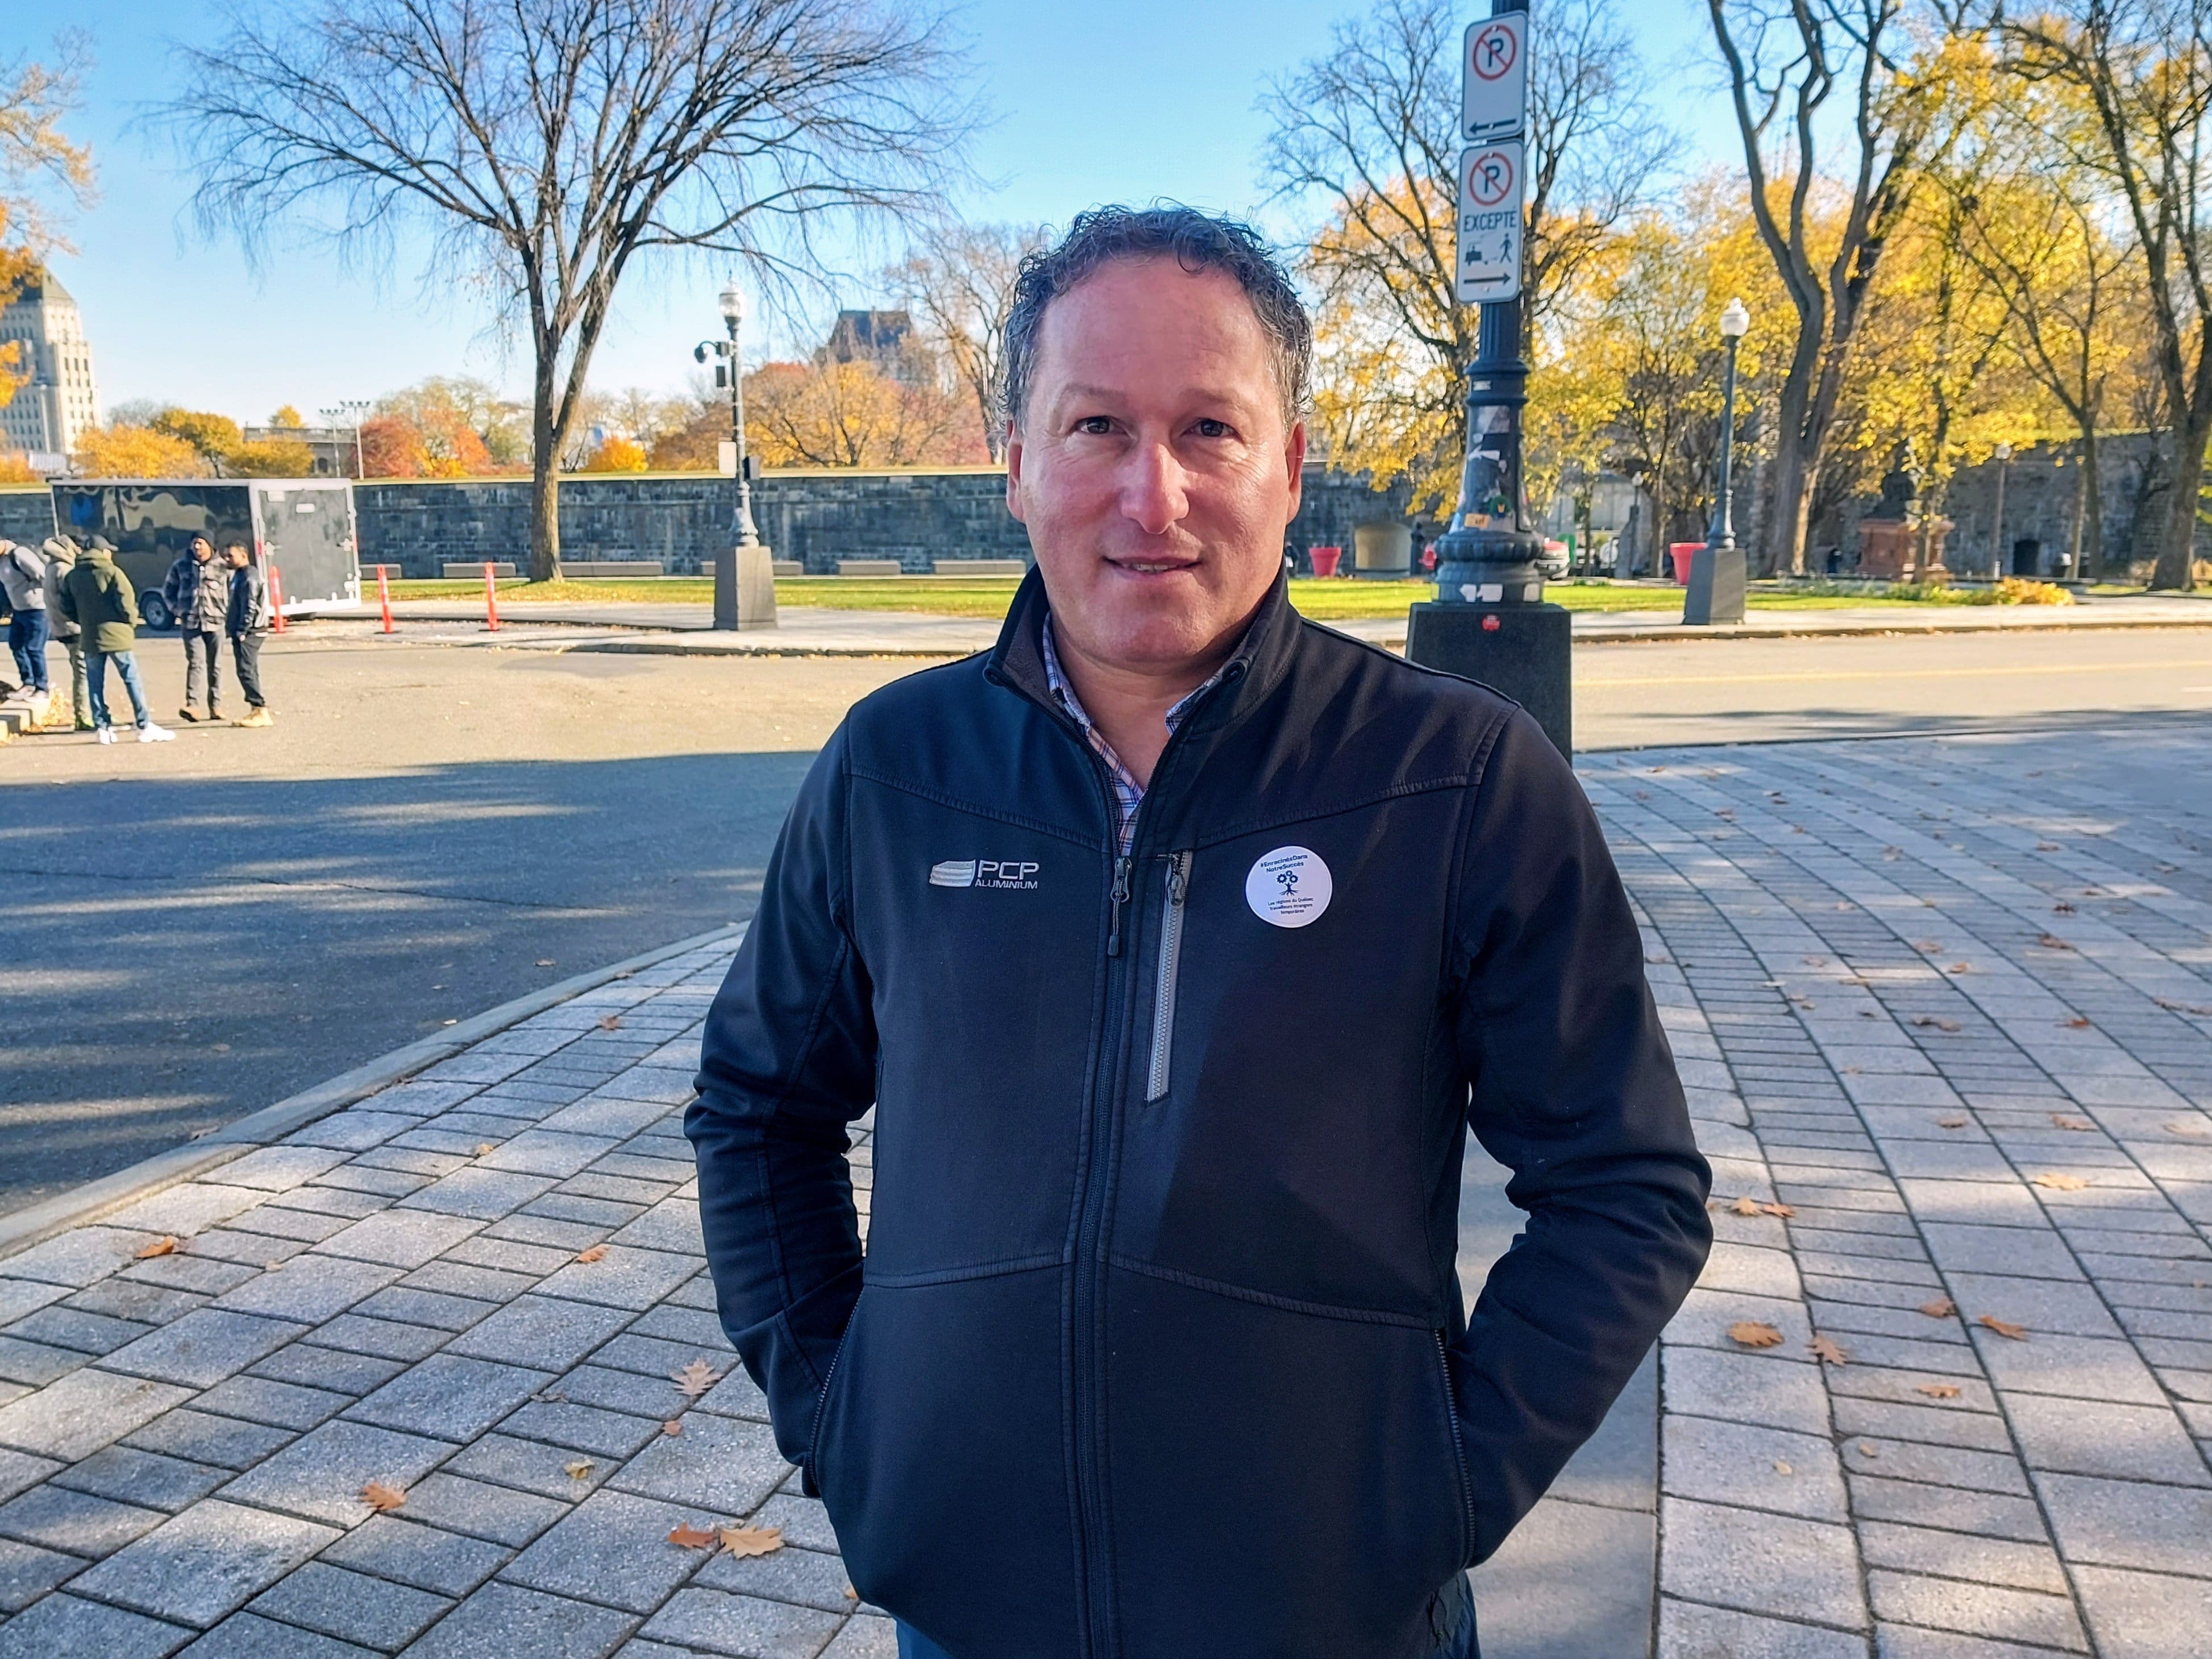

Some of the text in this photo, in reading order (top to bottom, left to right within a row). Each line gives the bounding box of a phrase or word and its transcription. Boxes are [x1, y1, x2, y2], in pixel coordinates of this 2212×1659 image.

[1488, 38, 1504, 68] P
[1485, 165, 1500, 193] P
[978, 860, 1040, 880] PCP
[975, 879, 1038, 889] ALUMINIUM
